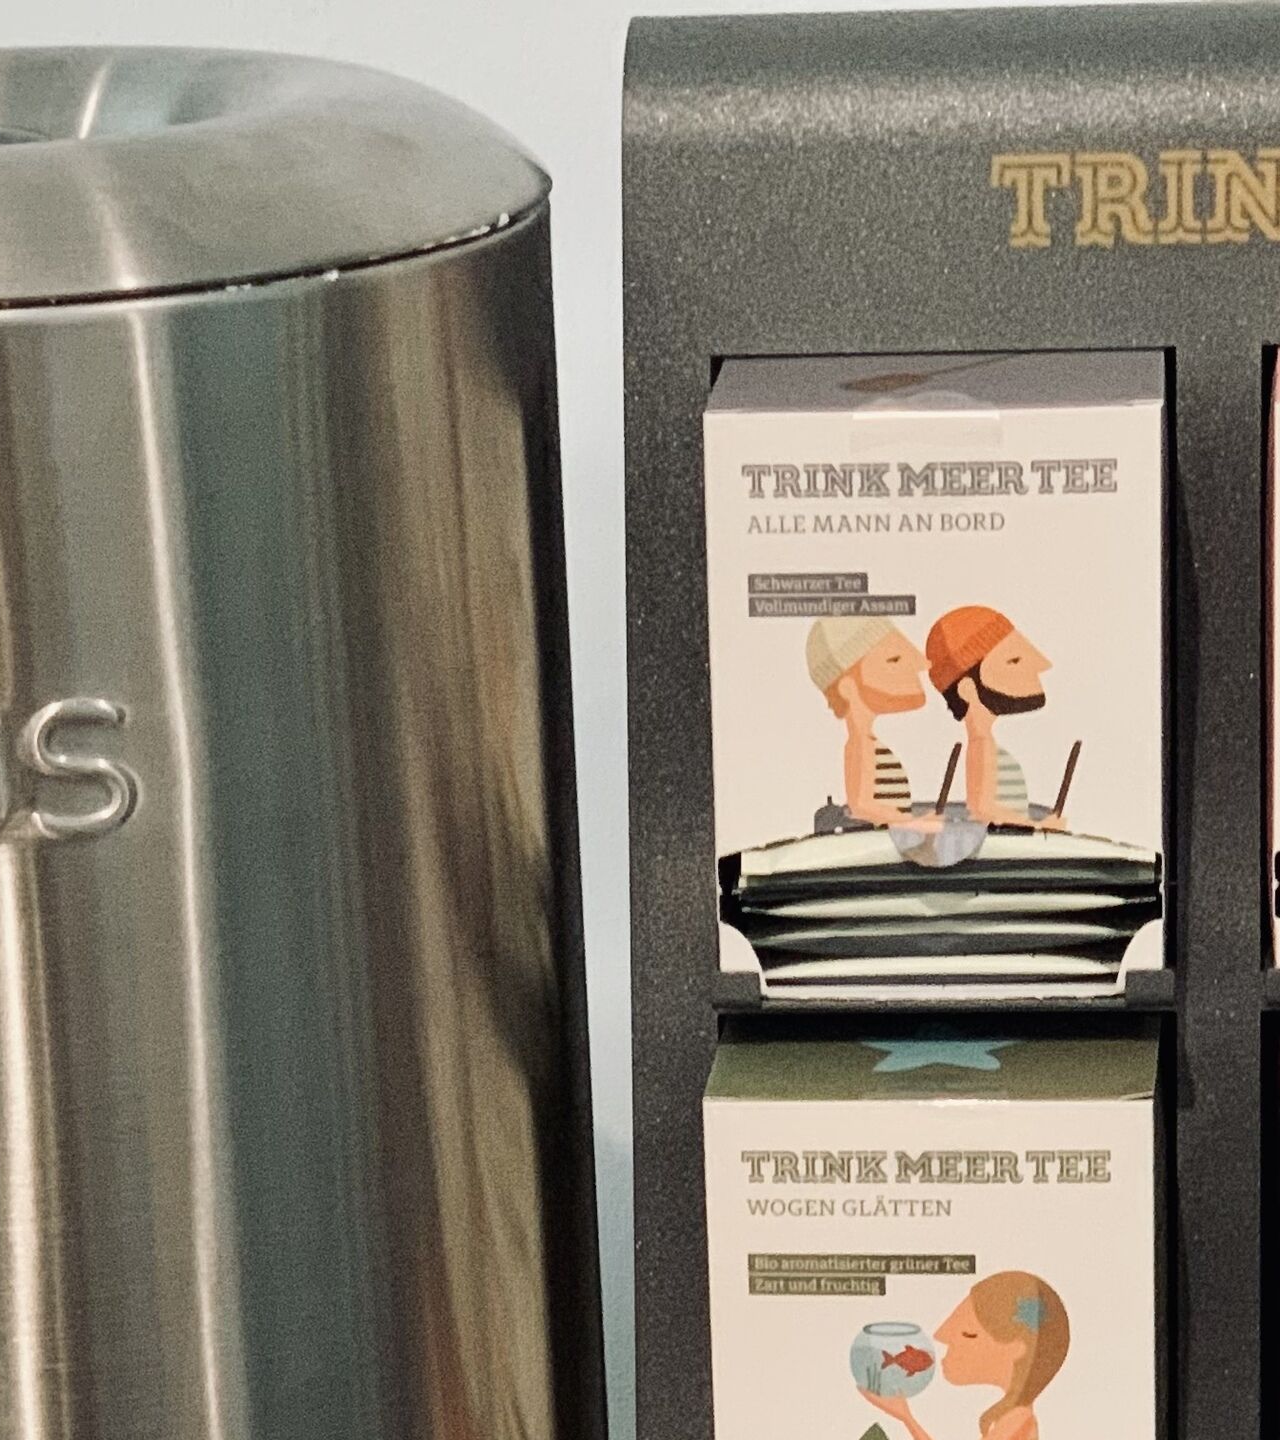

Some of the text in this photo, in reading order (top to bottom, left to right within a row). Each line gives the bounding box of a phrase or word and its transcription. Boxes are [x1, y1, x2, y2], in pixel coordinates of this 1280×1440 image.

[741, 458, 1118, 498] TRINK MEER TEE
[747, 512, 1006, 535] ALLE MANN AN BORD
[753, 575, 862, 592] Schwarzer Tee
[754, 597, 909, 616] Vollmundiger Assam
[741, 1150, 1111, 1184] TRINK MEER TEE
[747, 1195, 952, 1217] WOGEN GLÄTTEN
[755, 1256, 970, 1274] Bio aromatisierter grüner Tee
[754, 1277, 880, 1295] Zart und fruchtig
